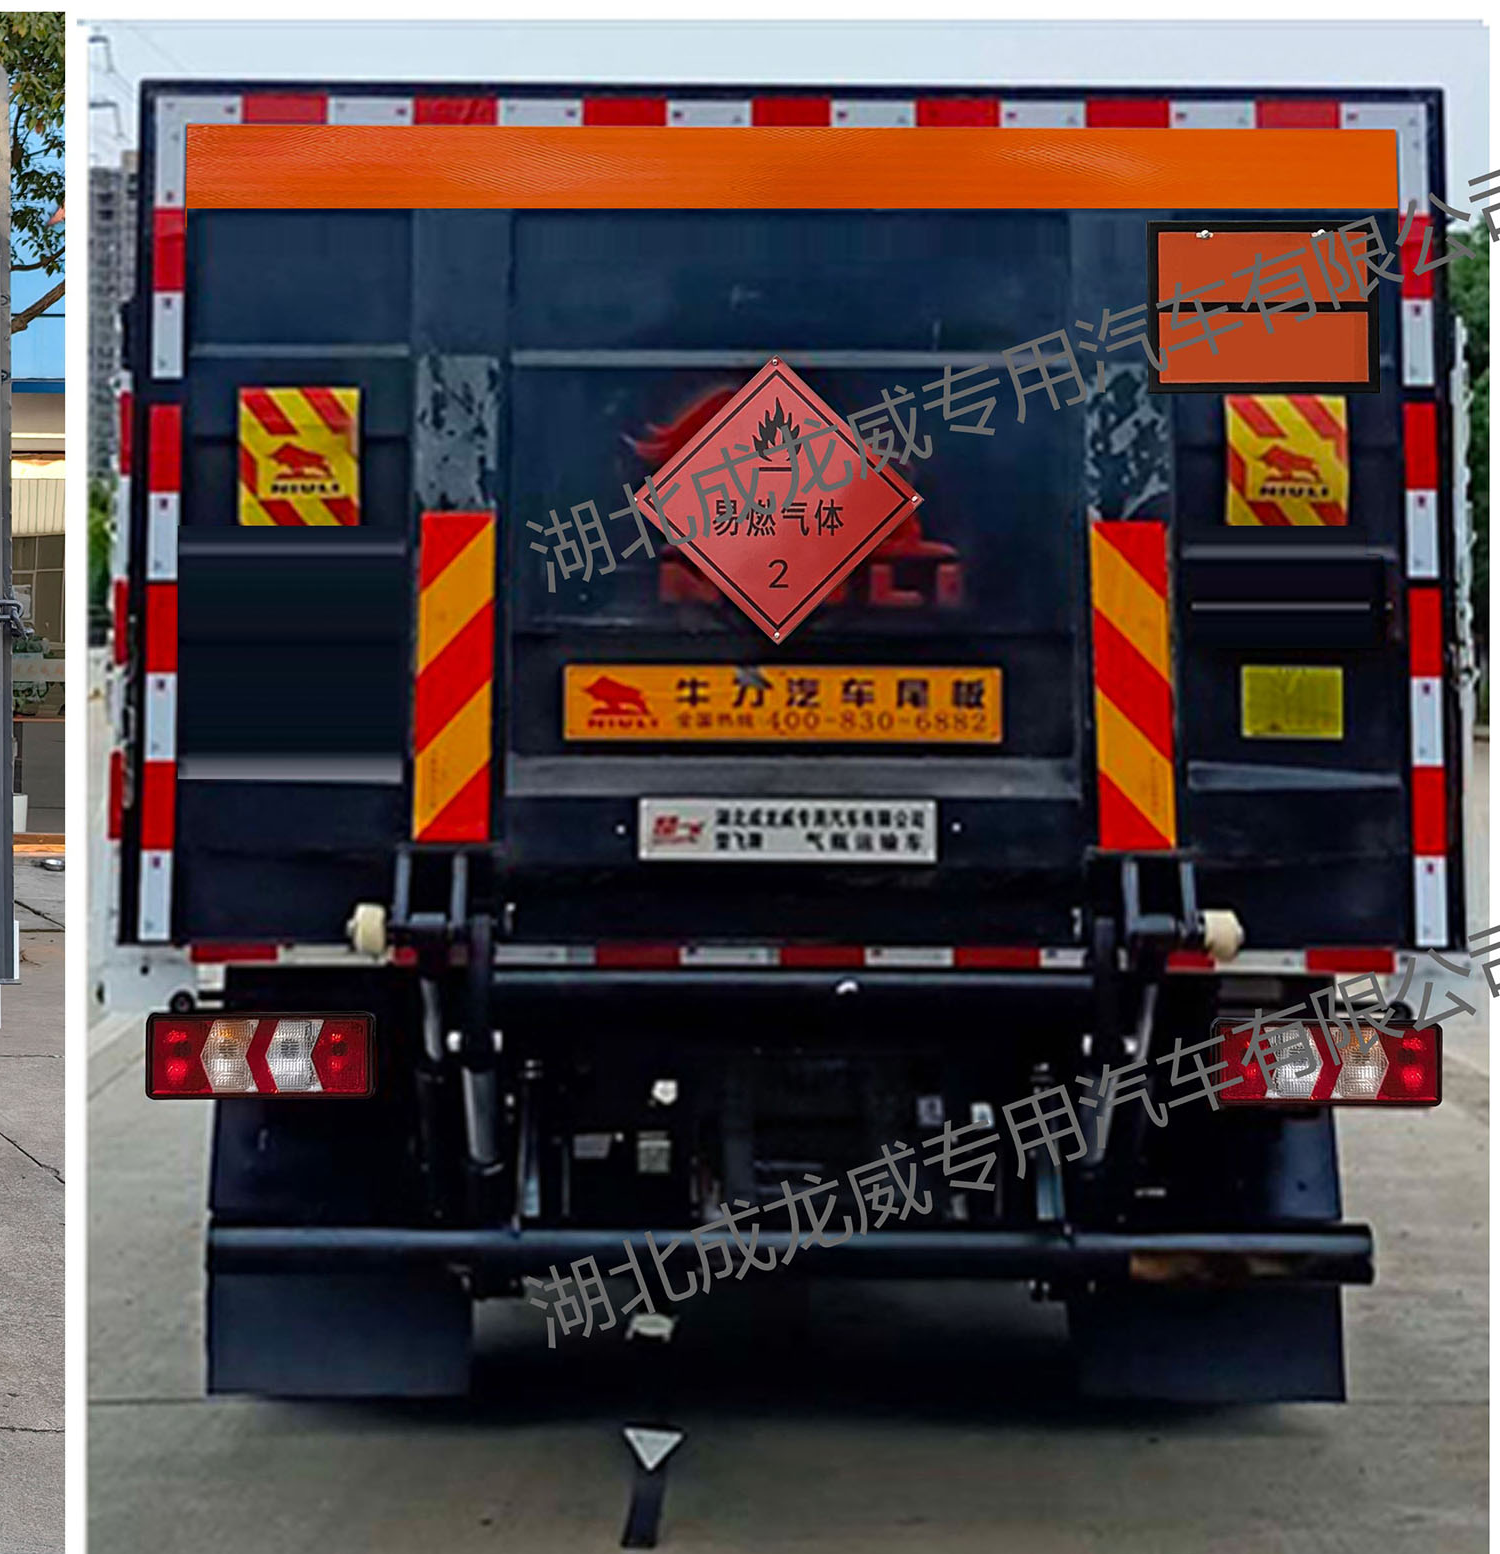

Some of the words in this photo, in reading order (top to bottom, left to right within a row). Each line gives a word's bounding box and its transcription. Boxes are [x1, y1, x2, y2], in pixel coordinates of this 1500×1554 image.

[712, 498, 845, 538] 易燃气体
[768, 558, 790, 589] 2
